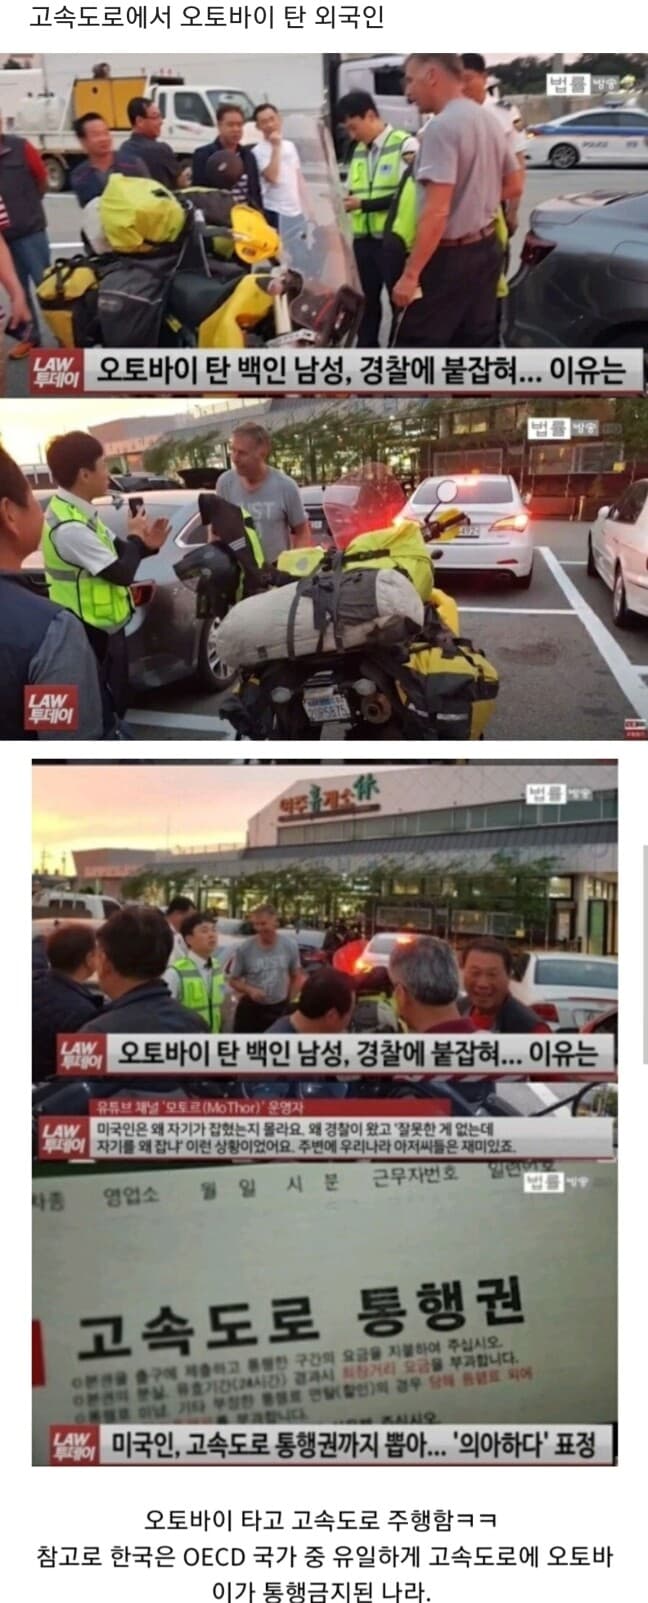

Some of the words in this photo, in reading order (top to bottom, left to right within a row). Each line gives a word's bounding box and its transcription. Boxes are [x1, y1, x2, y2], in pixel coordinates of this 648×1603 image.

[103, 1185, 160, 1208] 영업소
[201, 1181, 217, 1201] 월
[238, 1178, 256, 1199] 일
[286, 1175, 303, 1193] 시
[324, 1173, 340, 1192] 분
[372, 1165, 459, 1188] 근무자번호
[77, 1296, 320, 1360] 고속도로
[357, 1275, 525, 1338] 통행권
[448, 1336, 503, 1352] 주십시오.
[450, 1351, 519, 1369] 부과합니다.
